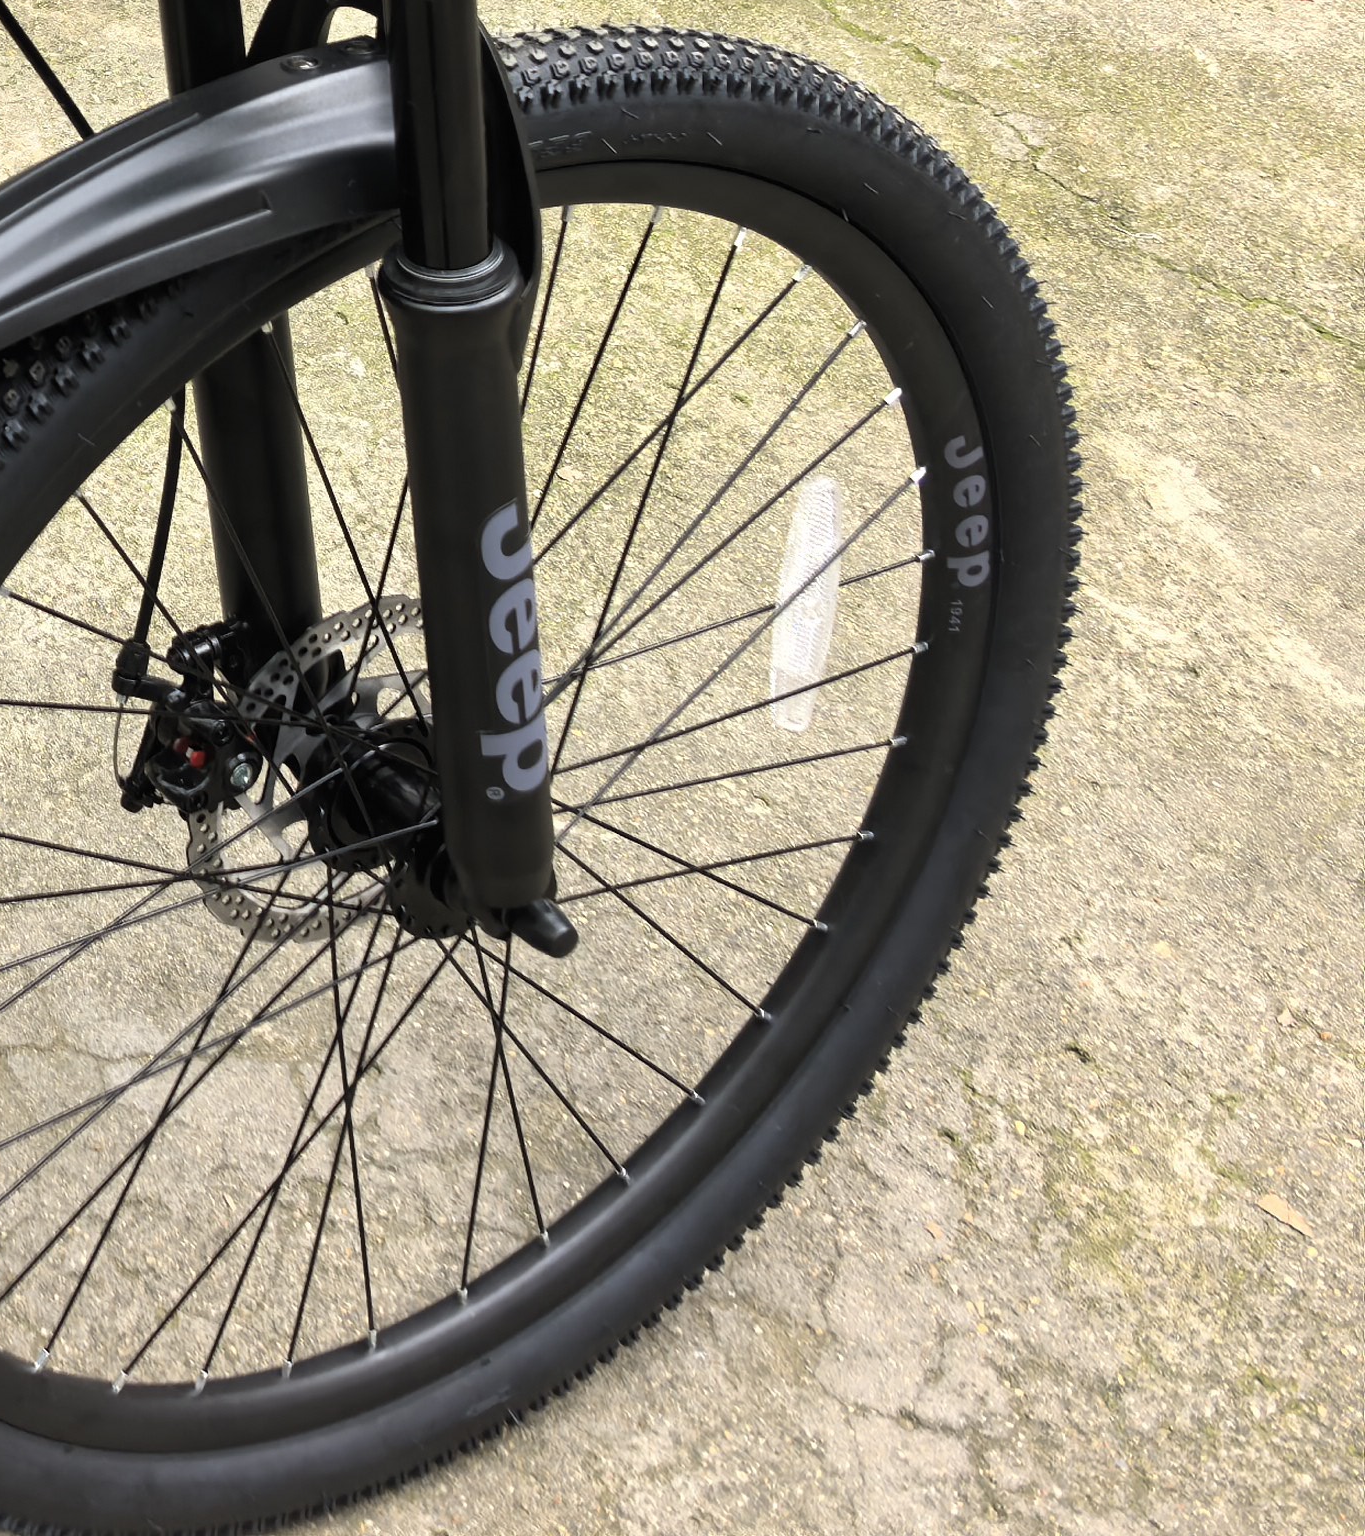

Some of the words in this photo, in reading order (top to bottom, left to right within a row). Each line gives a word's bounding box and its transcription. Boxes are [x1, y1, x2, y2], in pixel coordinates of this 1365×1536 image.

[943, 434, 991, 588] Jeep
[480, 497, 549, 793] Jeep
[948, 599, 964, 633] 1941
